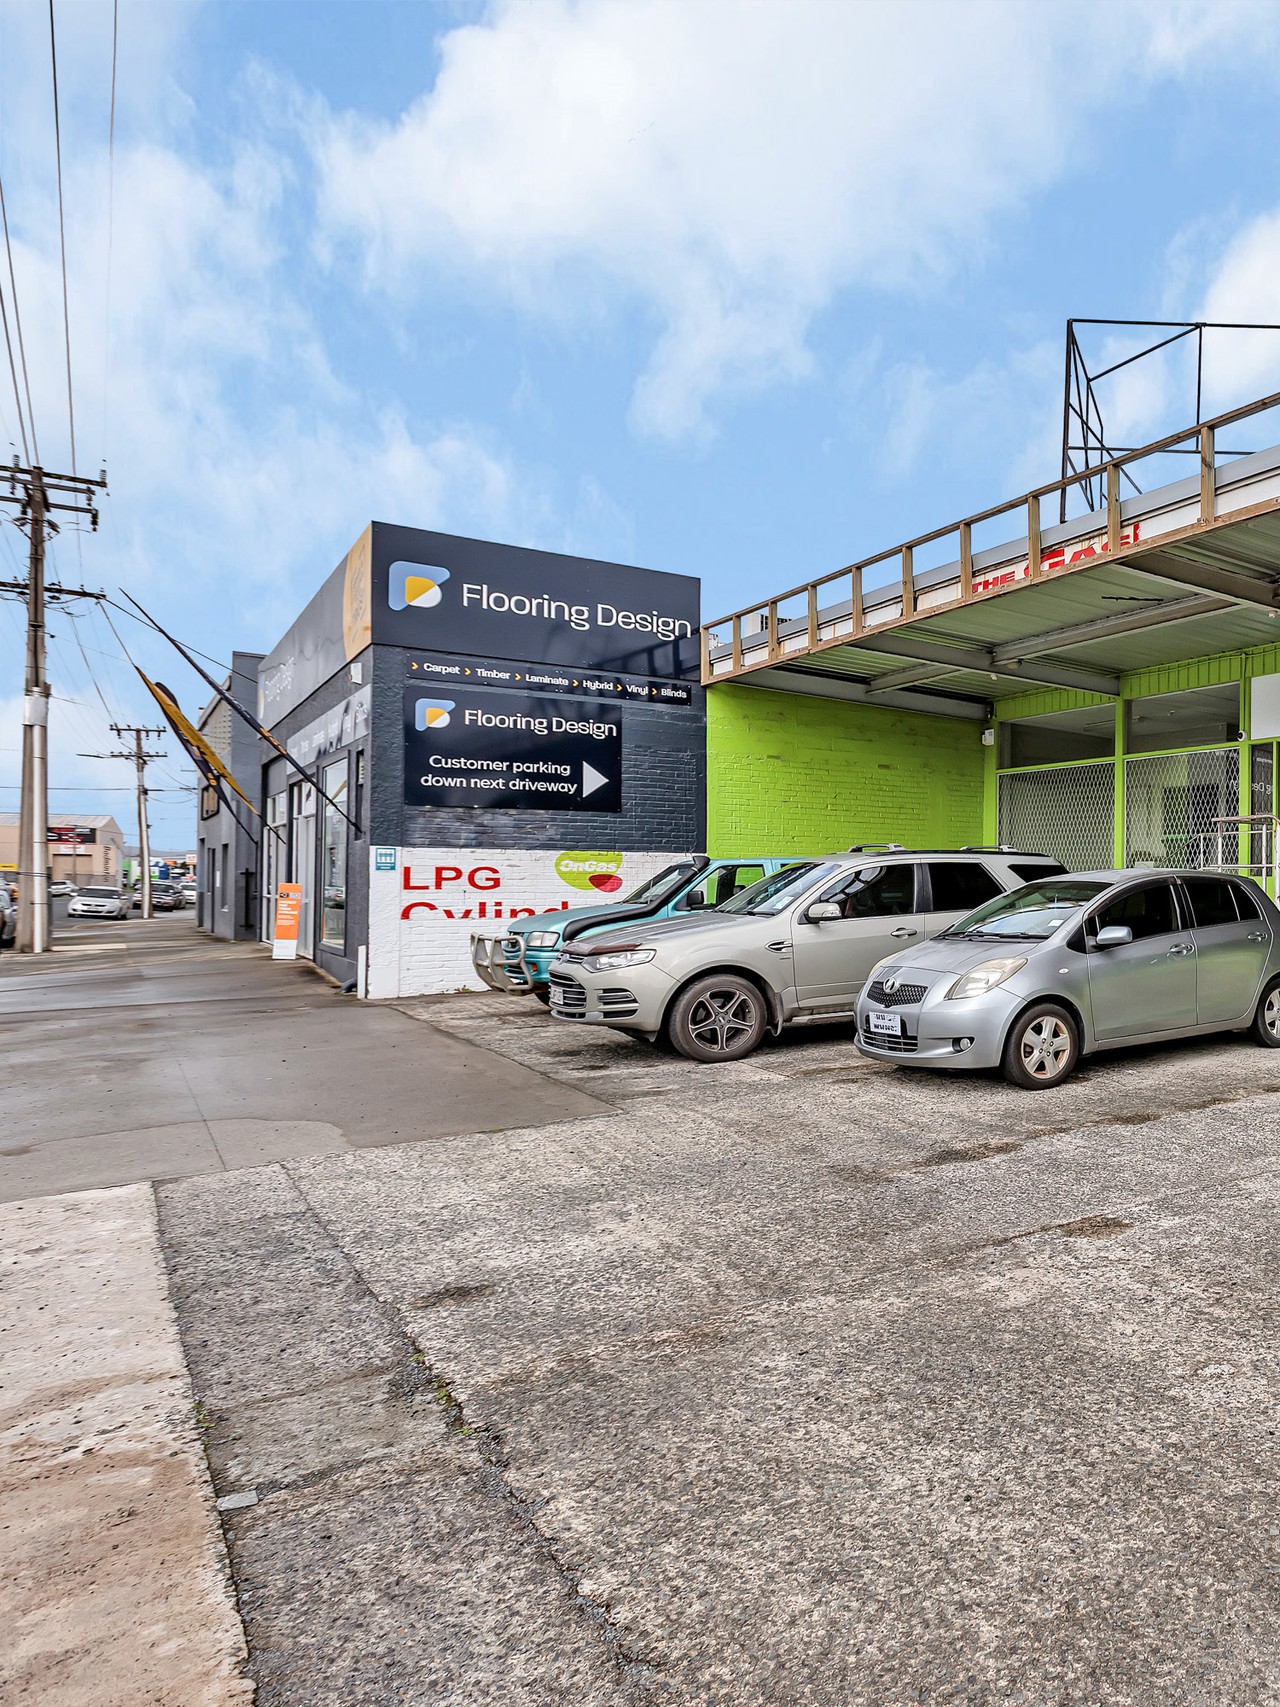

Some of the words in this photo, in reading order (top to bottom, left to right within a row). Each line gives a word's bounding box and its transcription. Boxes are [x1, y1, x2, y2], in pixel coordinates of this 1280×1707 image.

[972, 571, 1015, 593] THE
[462, 583, 590, 630] Flooring
[597, 604, 692, 641] Design
[423, 662, 461, 675] Carpet
[475, 668, 511, 680] Timber
[525, 674, 569, 686] Laminate
[582, 680, 614, 692] Hybrid
[626, 684, 649, 695] Vinyl
[661, 688, 688, 699] Blinds
[464, 709, 548, 735] Flooring
[552, 717, 617, 740] Design
[429, 755, 508, 772] Customer
[512, 759, 571, 776] parking
[420, 774, 466, 788] down
[470, 777, 506, 790] next
[509, 778, 578, 795] driveway
[560, 859, 618, 872] OnGas
[402, 866, 501, 891] LPG
